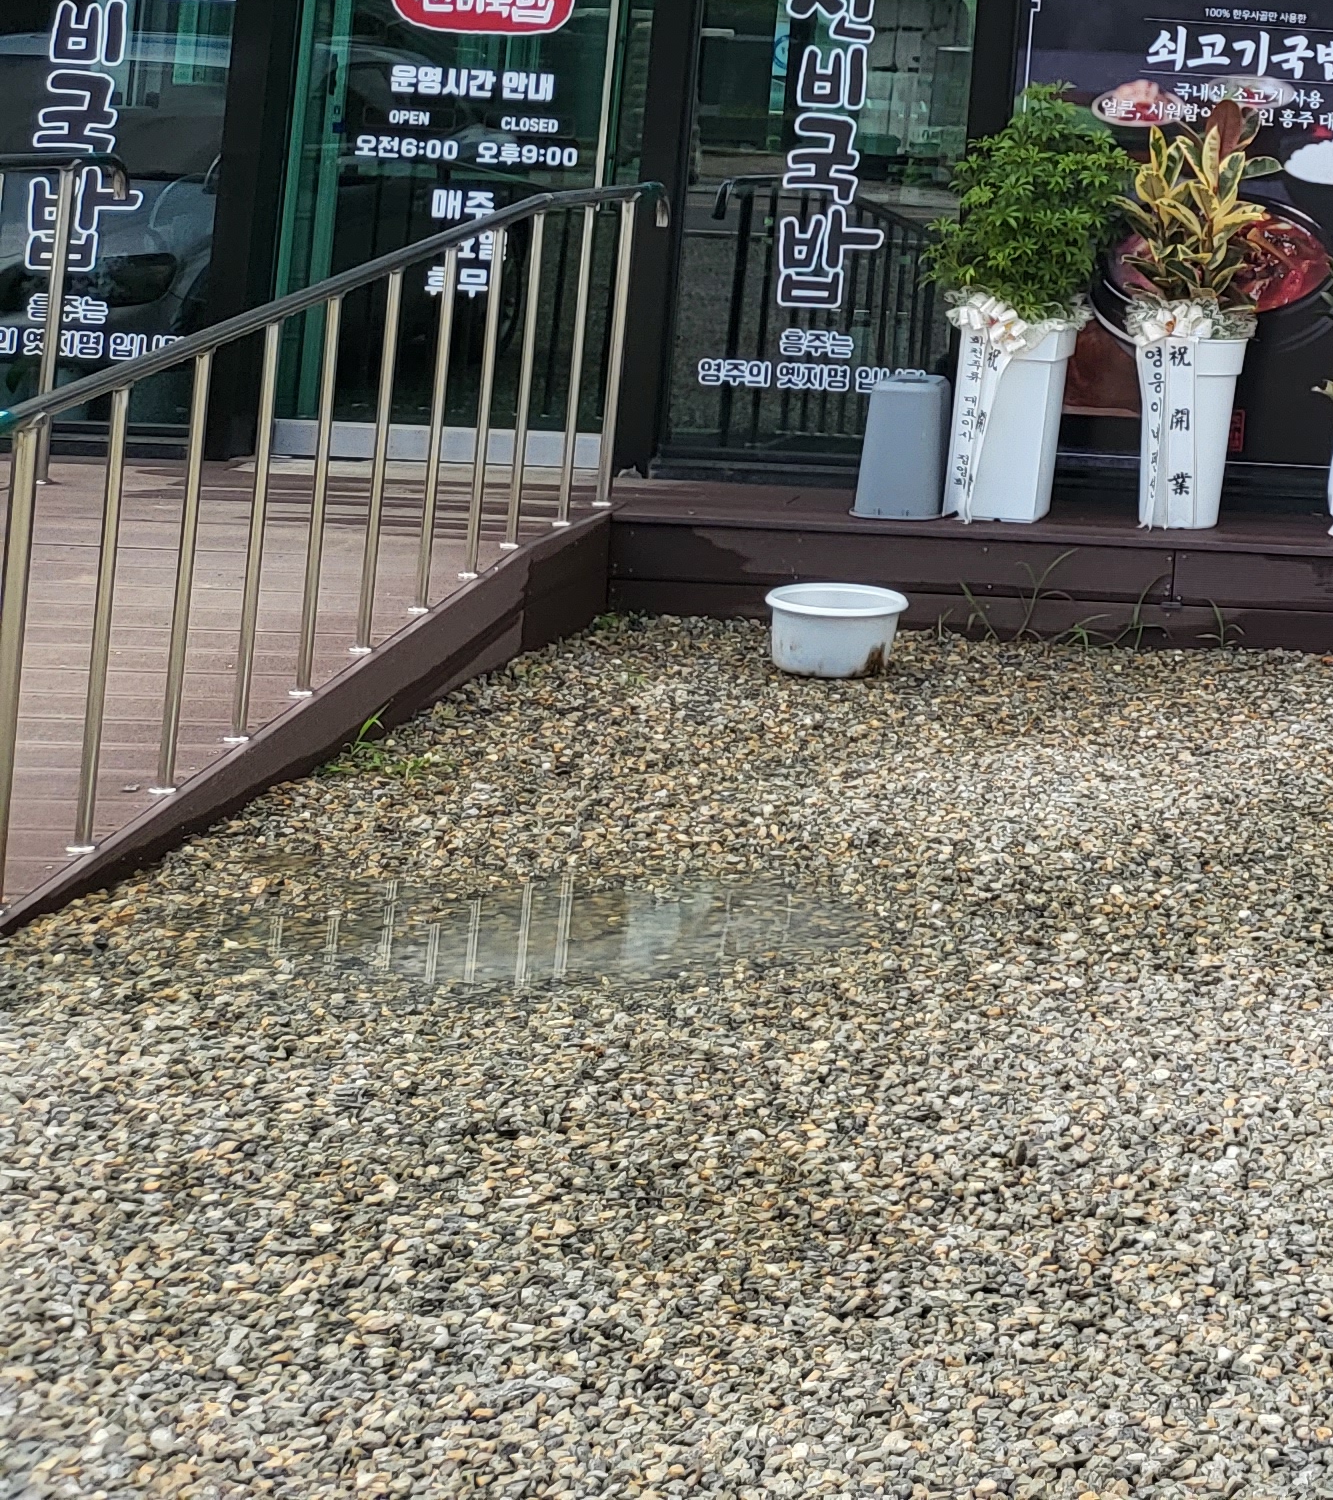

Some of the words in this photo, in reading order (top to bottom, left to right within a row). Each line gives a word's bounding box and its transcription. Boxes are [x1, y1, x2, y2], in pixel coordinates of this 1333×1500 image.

[1204, 7, 1231, 19] 100%
[1233, 9, 1278, 22] 한우사골만
[1279, 12, 1308, 25] 사용한
[390, 65, 496, 98] 운영시간
[502, 71, 555, 102] 안내
[1173, 82, 1228, 103] 국내산
[1232, 87, 1285, 106] 소고기
[1291, 90, 1325, 110] 사용
[388, 109, 431, 126] OPEN
[501, 116, 559, 134] CLOSED
[1278, 108, 1315, 130] 흥주
[354, 134, 459, 160] 오전6:00
[476, 141, 579, 168] 오후9:00
[430, 188, 496, 221] 매주
[780, 328, 854, 359] 흥주는
[698, 358, 772, 388] 영주의
[776, 362, 851, 392] 옛지명
